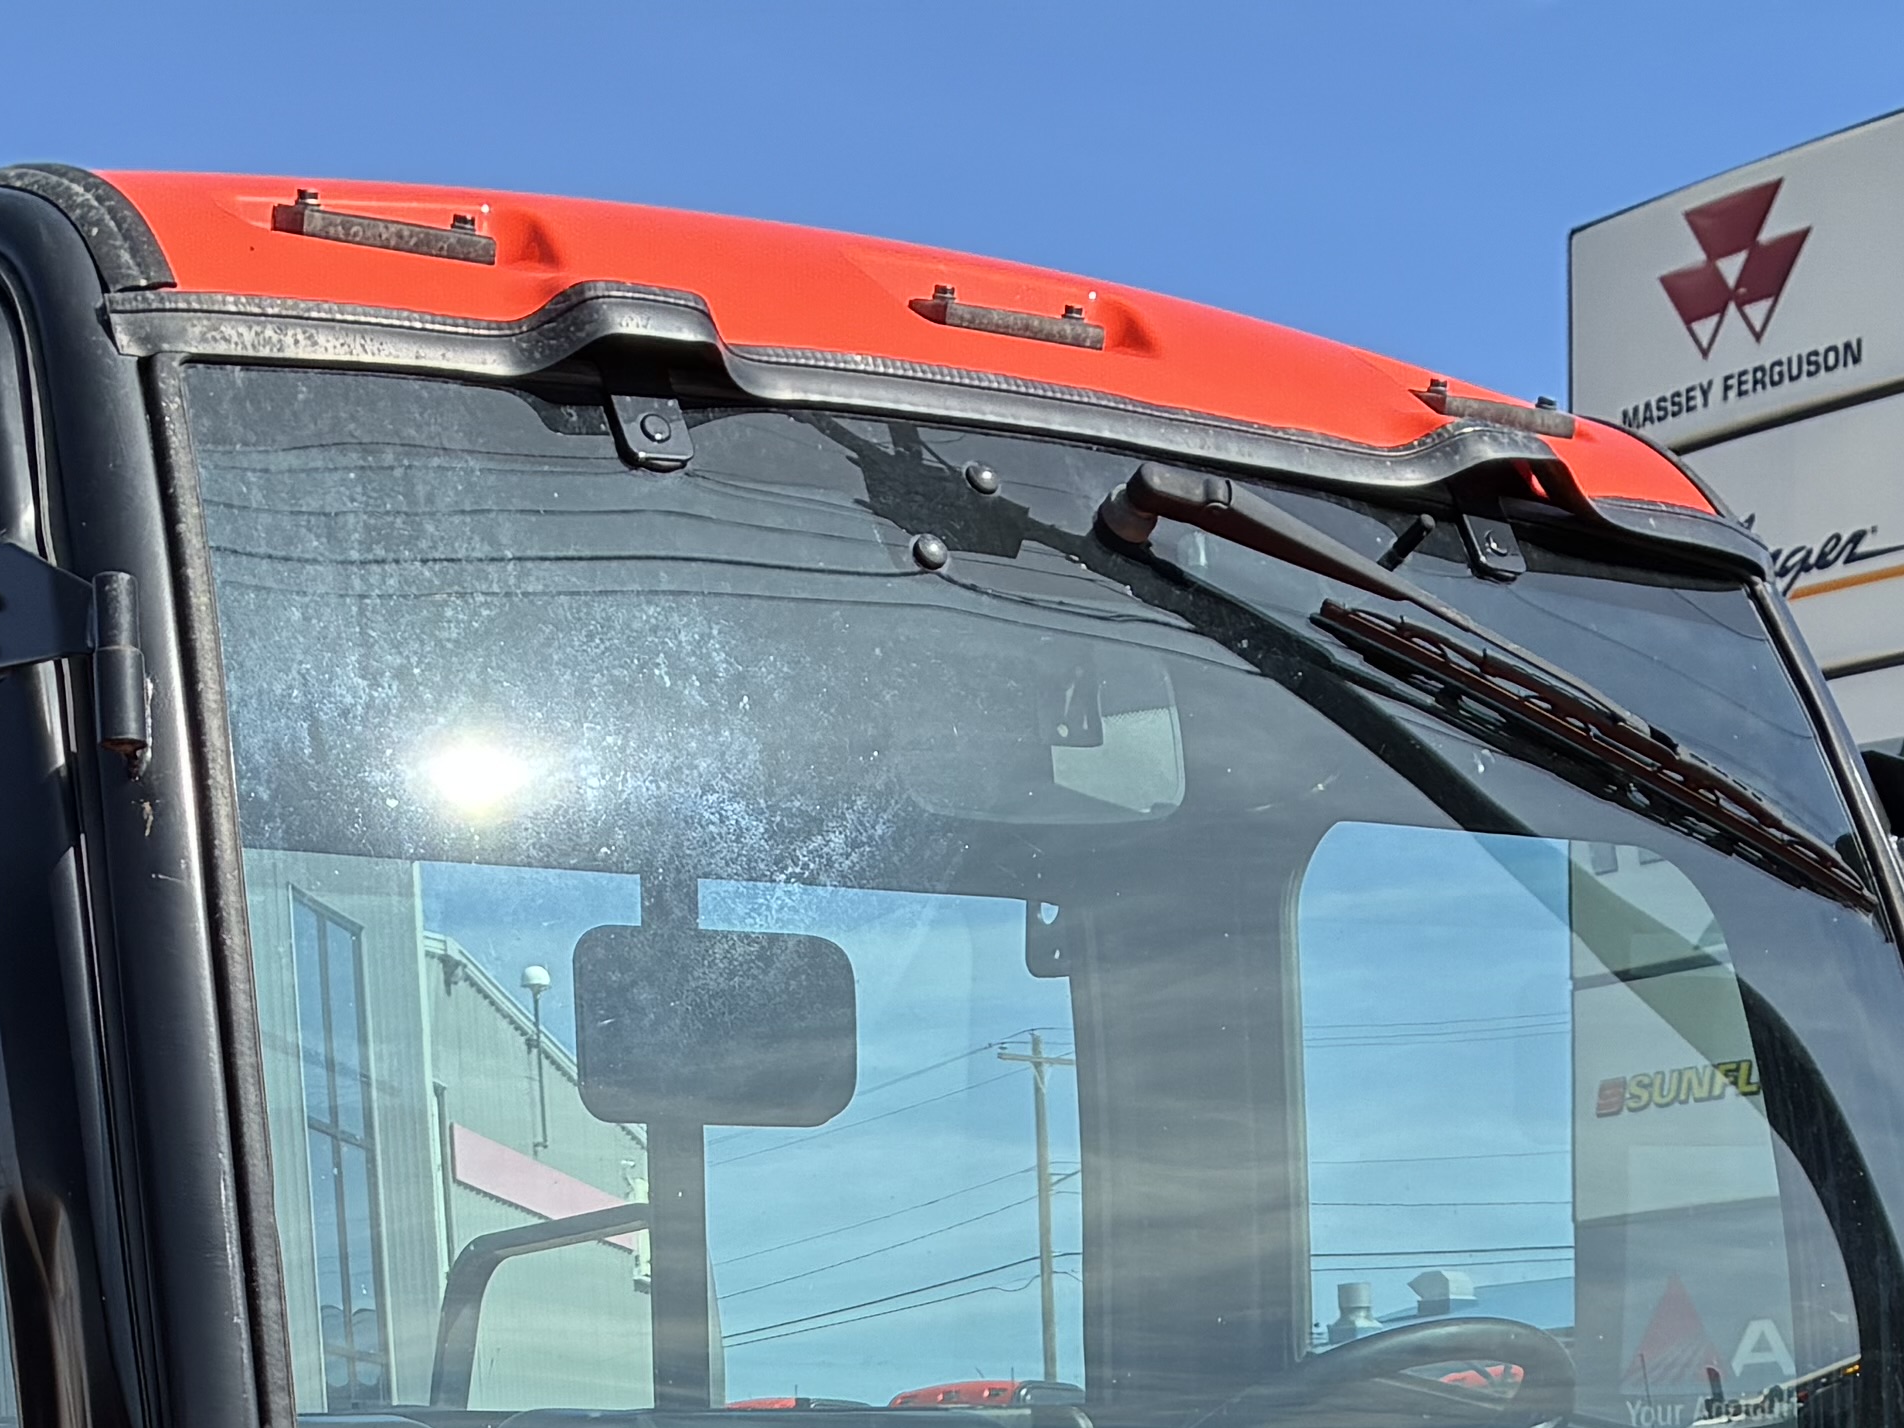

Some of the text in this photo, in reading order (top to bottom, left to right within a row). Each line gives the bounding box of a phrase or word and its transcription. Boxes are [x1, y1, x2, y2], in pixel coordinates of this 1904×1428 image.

[1621, 337, 1863, 430] MASSEY FERGUSON
[1625, 1400, 1684, 1427] Your
